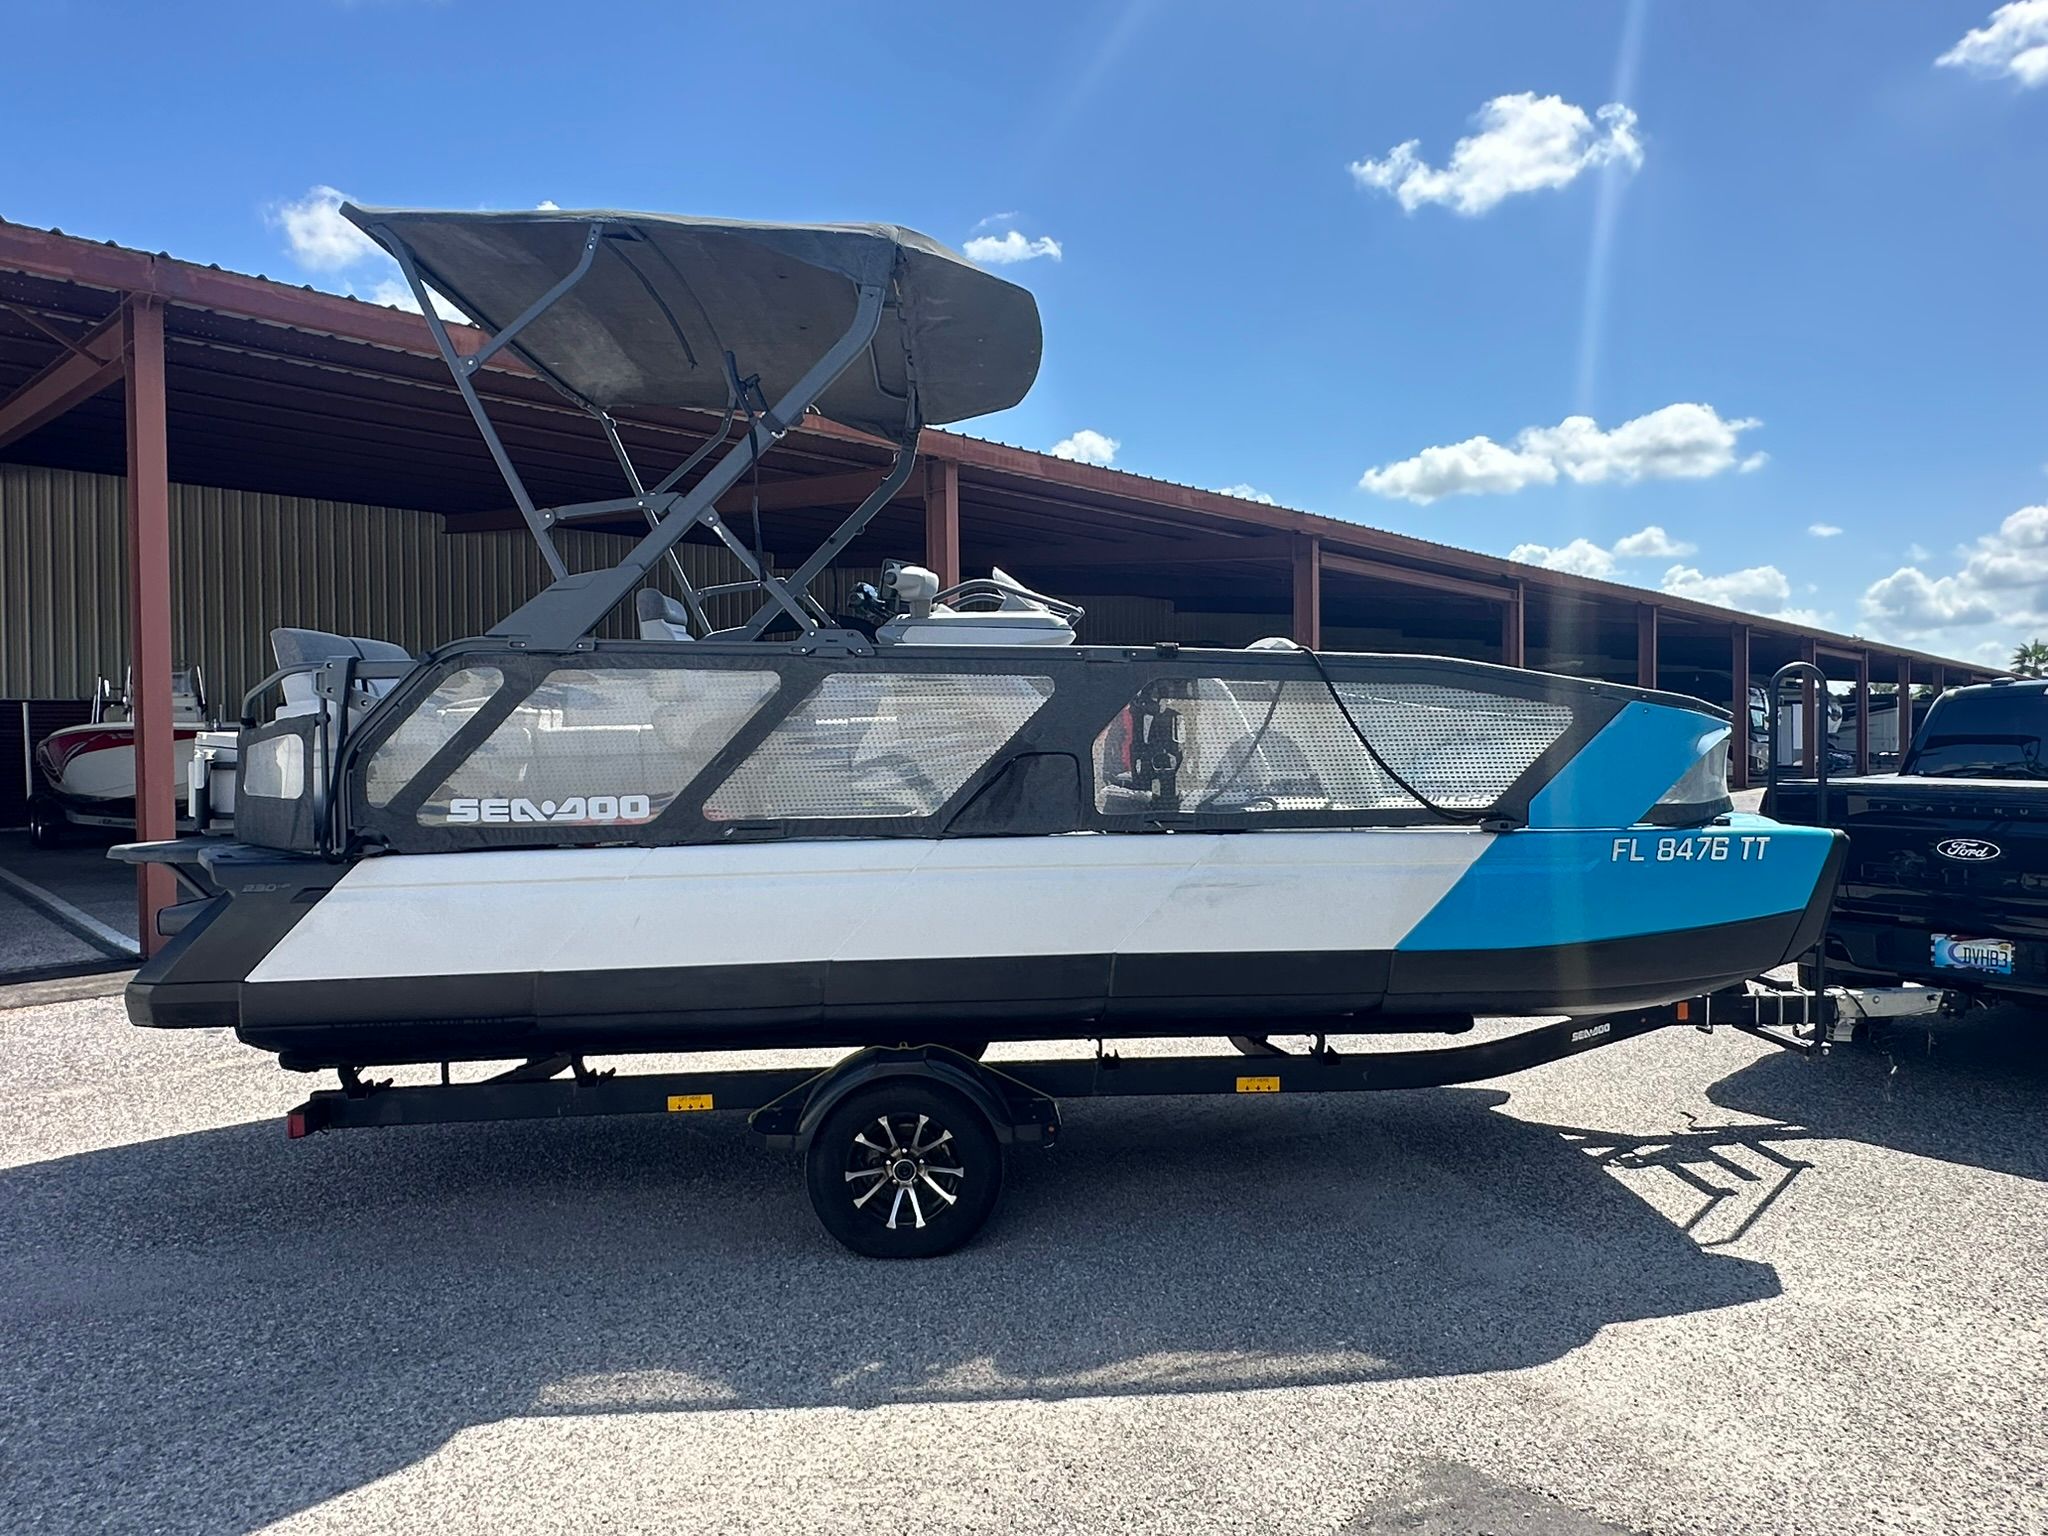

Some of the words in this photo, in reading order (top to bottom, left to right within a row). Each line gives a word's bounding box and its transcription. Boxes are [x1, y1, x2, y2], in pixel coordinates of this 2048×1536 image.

[1880, 803, 2030, 816] PLATINU
[1611, 838, 1645, 862] FL
[1656, 837, 1730, 861] 8476
[1740, 836, 1771, 861] TT
[1946, 841, 1989, 858] Ford
